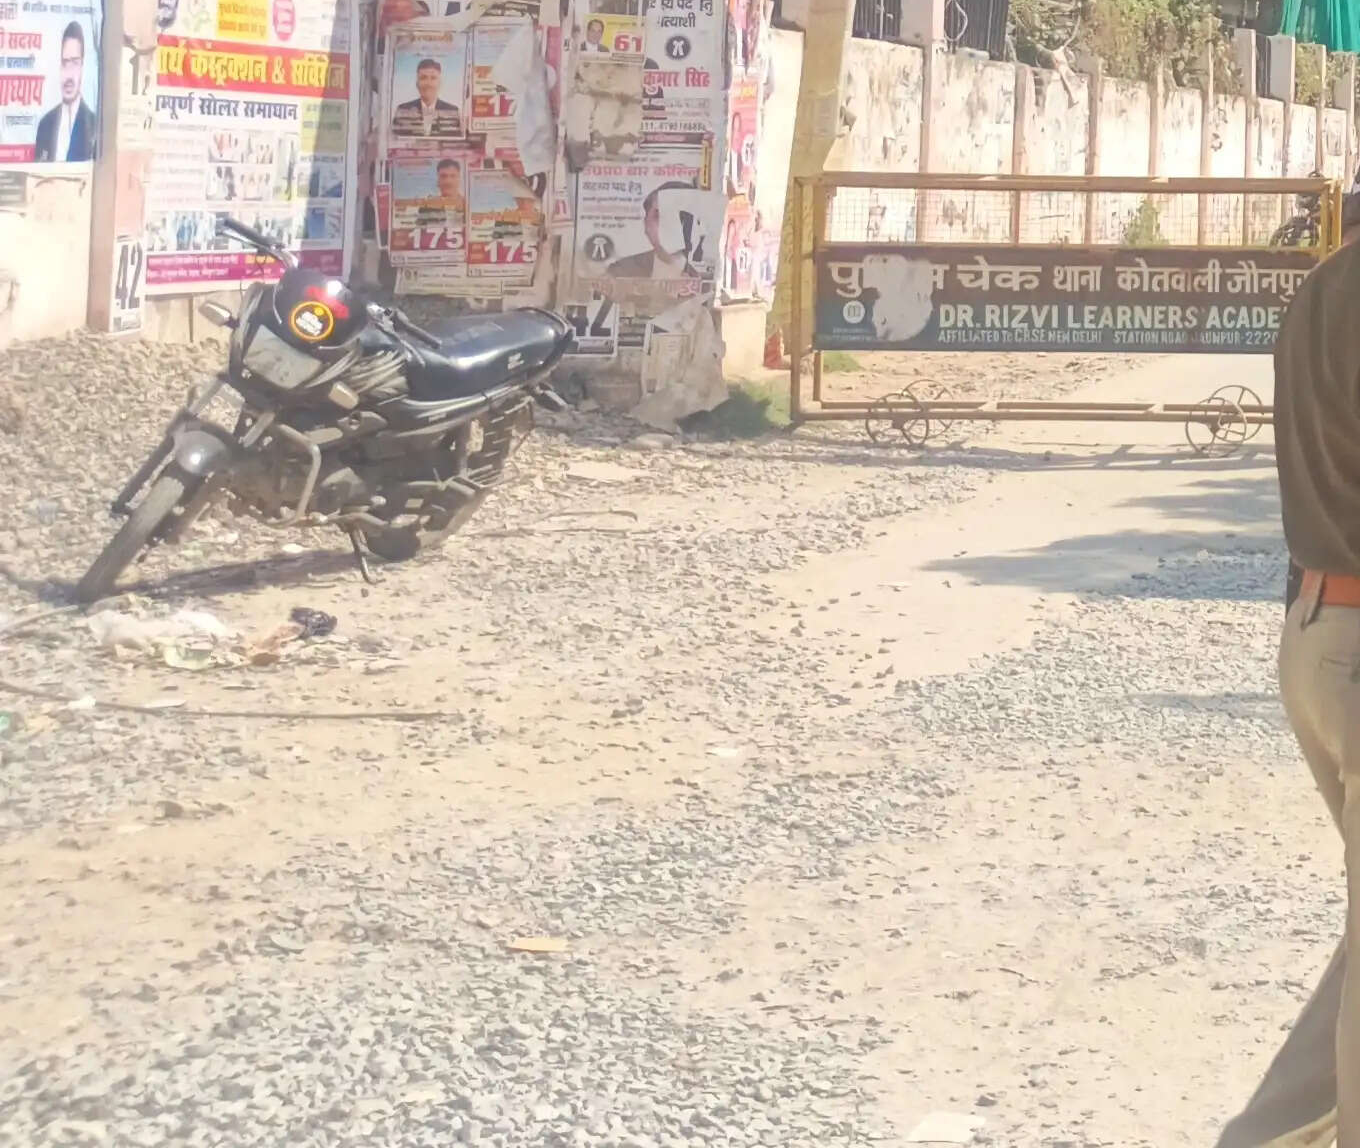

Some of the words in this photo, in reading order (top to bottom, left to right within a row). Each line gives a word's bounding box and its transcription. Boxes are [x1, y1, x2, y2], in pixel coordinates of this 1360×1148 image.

[272, 56, 286, 85] &
[684, 65, 711, 88] सिंह
[198, 93, 240, 117] सोलर
[243, 100, 298, 120] समाधान
[407, 227, 465, 250] 175
[484, 240, 539, 264] 175
[957, 255, 1043, 292] चेक
[1053, 265, 1103, 293] थाना
[1116, 257, 1222, 294] कोतवाली
[1206, 306, 1288, 330] ACADE
[938, 330, 1000, 344] AFFILIATED
[1049, 330, 1071, 343] NEW
[1113, 332, 1160, 345] STATION
